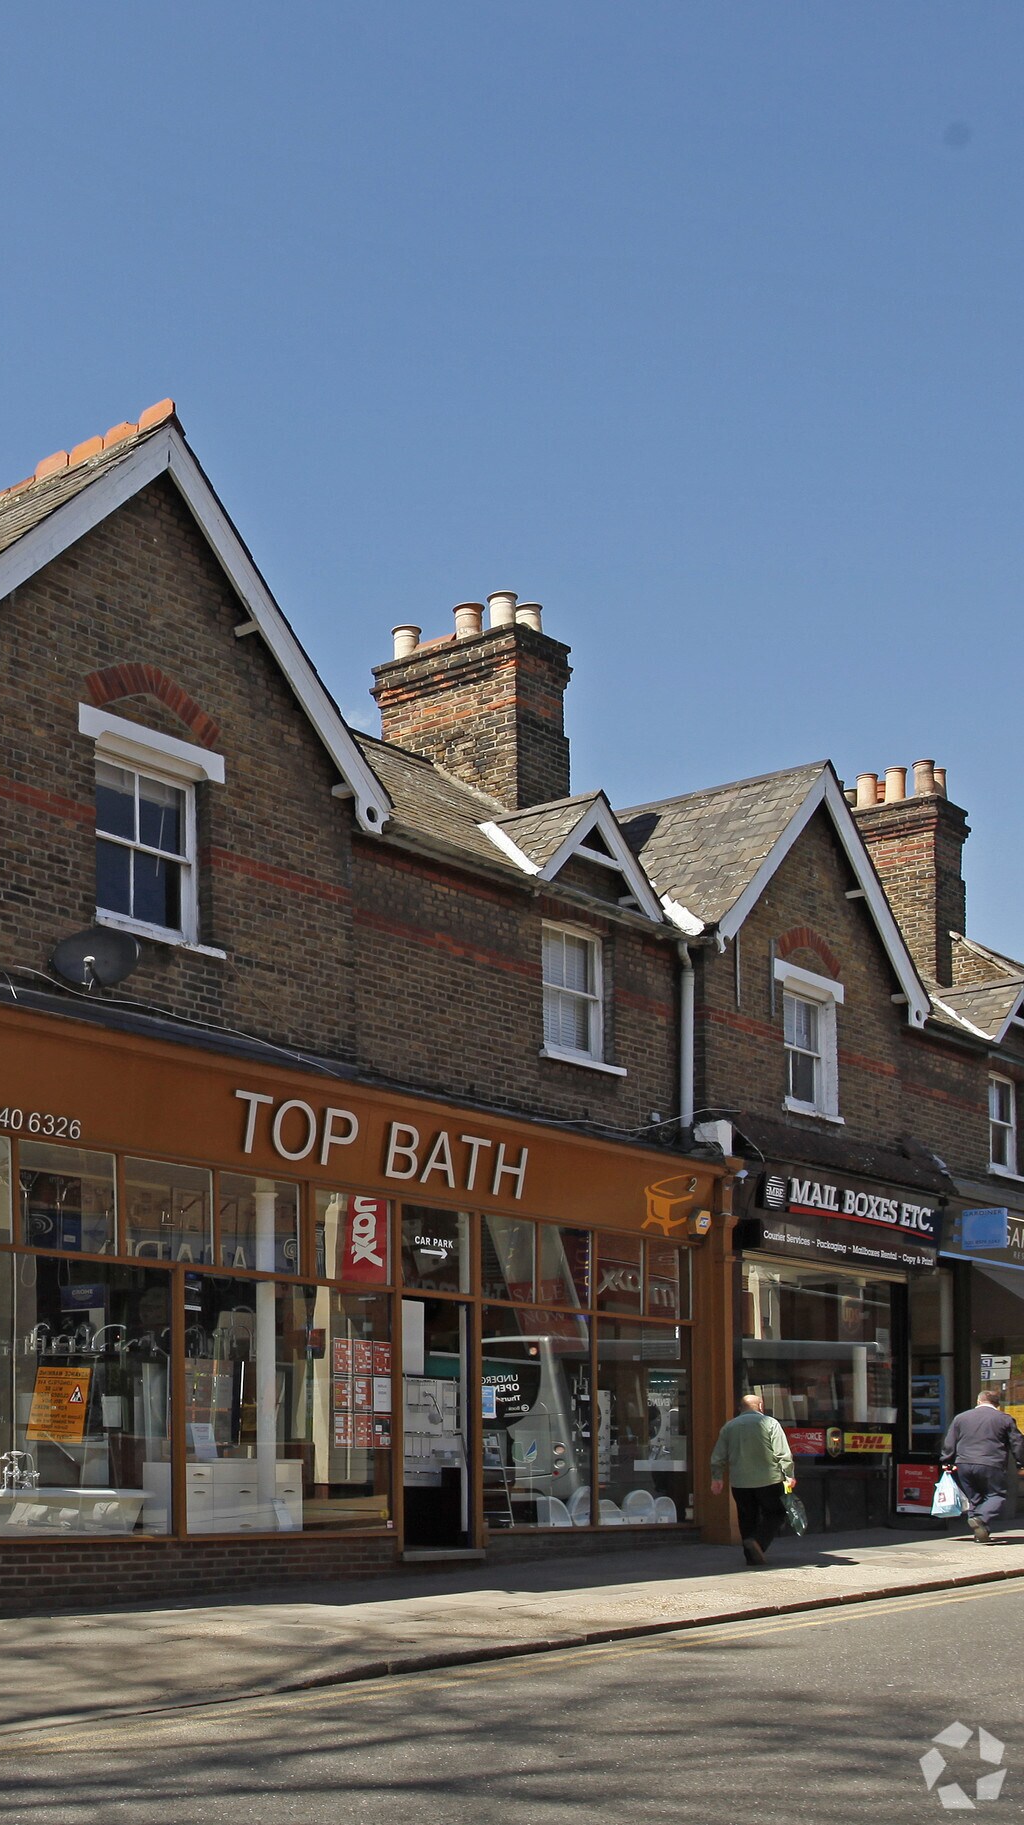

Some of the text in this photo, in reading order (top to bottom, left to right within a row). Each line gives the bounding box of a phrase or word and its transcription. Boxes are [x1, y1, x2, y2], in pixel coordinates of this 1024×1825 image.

[28, 1112, 82, 1140] 6326
[235, 1089, 529, 1201] TOP BATH
[688, 1177, 698, 1192] 2
[767, 1187, 784, 1197] MBE
[789, 1178, 934, 1232] MAIL BOXES ETC.
[414, 1235, 454, 1249] CAR PARK
[763, 1230, 785, 1242] Courier
[786, 1233, 810, 1246] Services
[816, 1239, 847, 1254] Packaging
[852, 1245, 880, 1258] Mailboxes
[880, 1250, 897, 1260] Rental
[902, 1253, 916, 1265] Copy
[921, 1257, 934, 1266] Print
[851, 1435, 886, 1449] DHL
